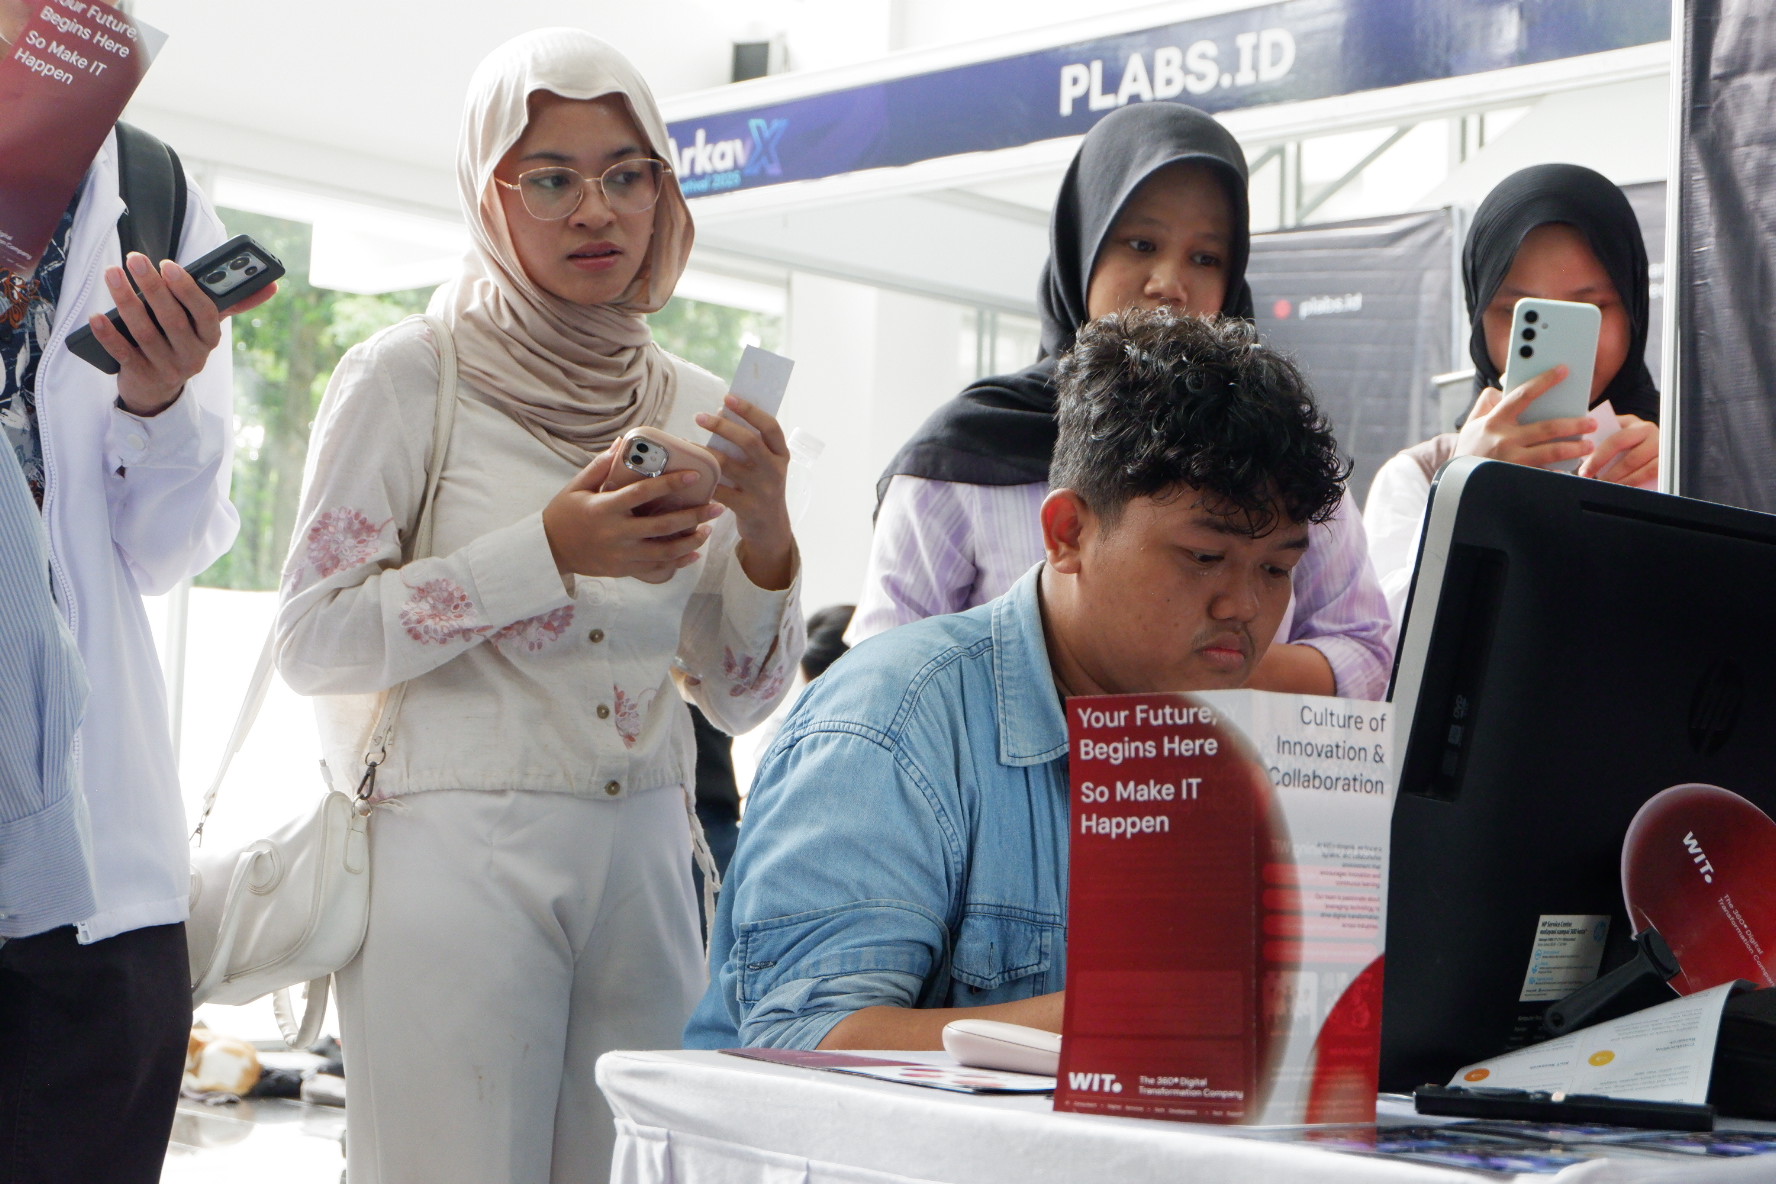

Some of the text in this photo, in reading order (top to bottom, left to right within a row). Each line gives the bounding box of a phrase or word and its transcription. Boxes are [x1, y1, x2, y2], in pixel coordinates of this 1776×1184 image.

[40, 5, 130, 58] Begins Here
[55, 0, 137, 42] our Future,
[14, 47, 73, 85] Happen
[26, 30, 107, 76] So Make IT
[1059, 27, 1297, 117] PLABS.ID
[1077, 704, 1217, 728] Your Future,
[1300, 705, 1386, 732] Culture of
[1079, 735, 1218, 765] Begins Here
[1276, 735, 1384, 764] Innovation &
[1080, 778, 1202, 803] So Make IT
[1080, 813, 1170, 840] Happen
[1682, 830, 1715, 884] WIT.
[1717, 897, 1775, 986] Transformation Compan
[1723, 894, 1734, 909] The
[1745, 928, 1764, 955] Digital
[1068, 1072, 1123, 1094] WIT.
[1139, 1075, 1155, 1085] The
[1180, 1077, 1207, 1089] Digital
[1138, 1086, 1244, 1100] Transformation Company
